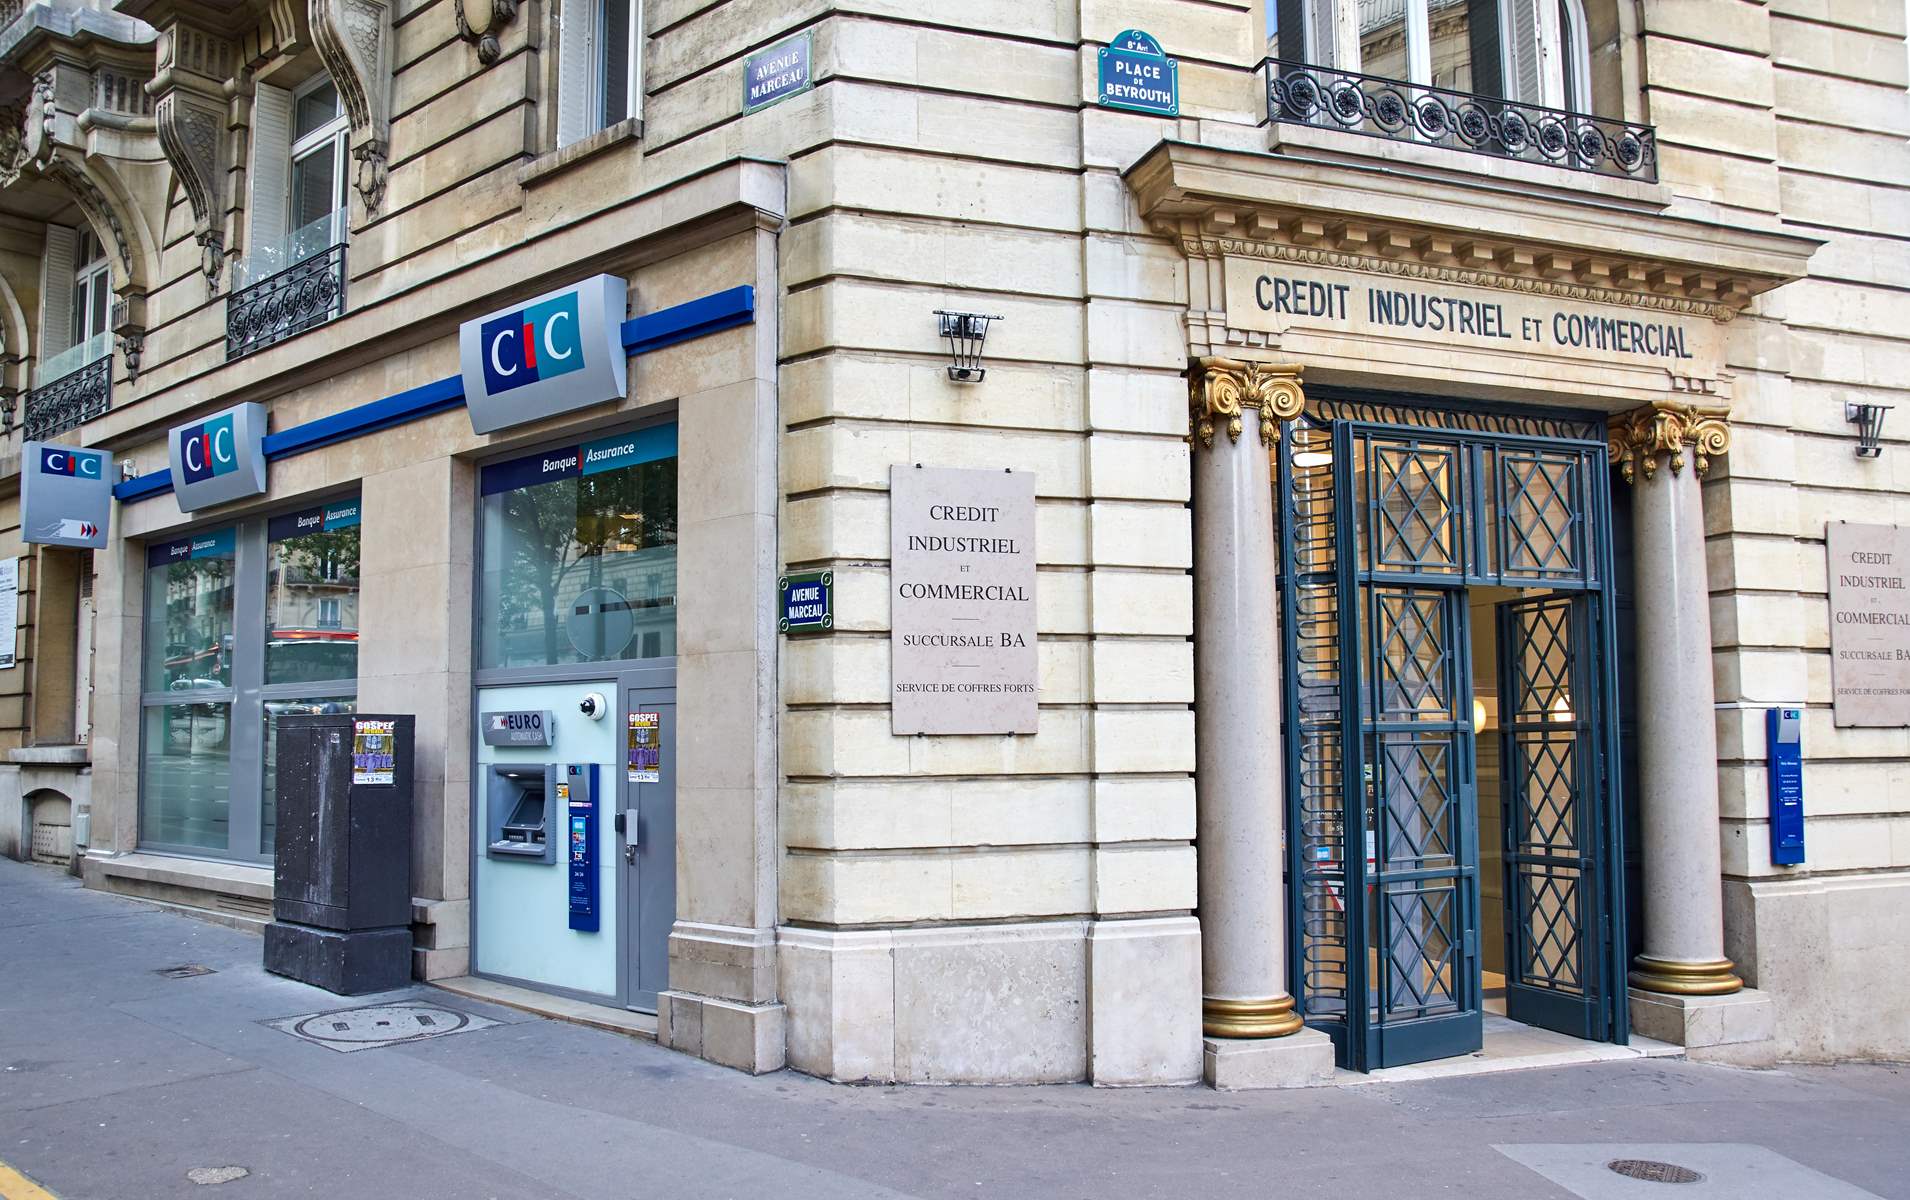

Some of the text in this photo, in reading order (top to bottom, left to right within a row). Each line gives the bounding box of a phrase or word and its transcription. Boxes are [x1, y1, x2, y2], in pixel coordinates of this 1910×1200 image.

[756, 51, 799, 81] AVENUE
[1115, 61, 1161, 79] PLACE
[751, 67, 804, 100] MARCEAU
[1133, 78, 1144, 86] DE
[1106, 83, 1171, 104] BEYROUTH
[1255, 275, 1693, 359] CREDIT INDUSTRIEL ET COMMERCIAL
[491, 311, 572, 377] CIC
[186, 427, 231, 472] CIC
[542, 443, 635, 472] Banque Assurance
[47, 453, 97, 475] CIC
[297, 507, 357, 528] Banque Assurance
[930, 505, 999, 522] CREDIT
[170, 539, 216, 557] Banque Assurance
[908, 535, 1020, 554] INDUSTRIEL
[1851, 551, 1892, 565] CREDIT
[960, 565, 970, 573] ET
[1839, 574, 1906, 590] INDUSTRIEL
[791, 587, 820, 603] AVENUE
[899, 583, 1030, 601] COMMERCIAL
[788, 604, 823, 620] MARCEAU
[1836, 611, 1910, 626] COMMERCIAL
[903, 632, 1026, 648] SUCCURSALE BA
[1839, 650, 1893, 661] SUCCURSALE
[896, 683, 1034, 693] SERVICE DE COFFRES FORTS
[355, 721, 394, 730] GOSPEL
[508, 714, 541, 729] EURO
[629, 713, 658, 722] GOSPEL
